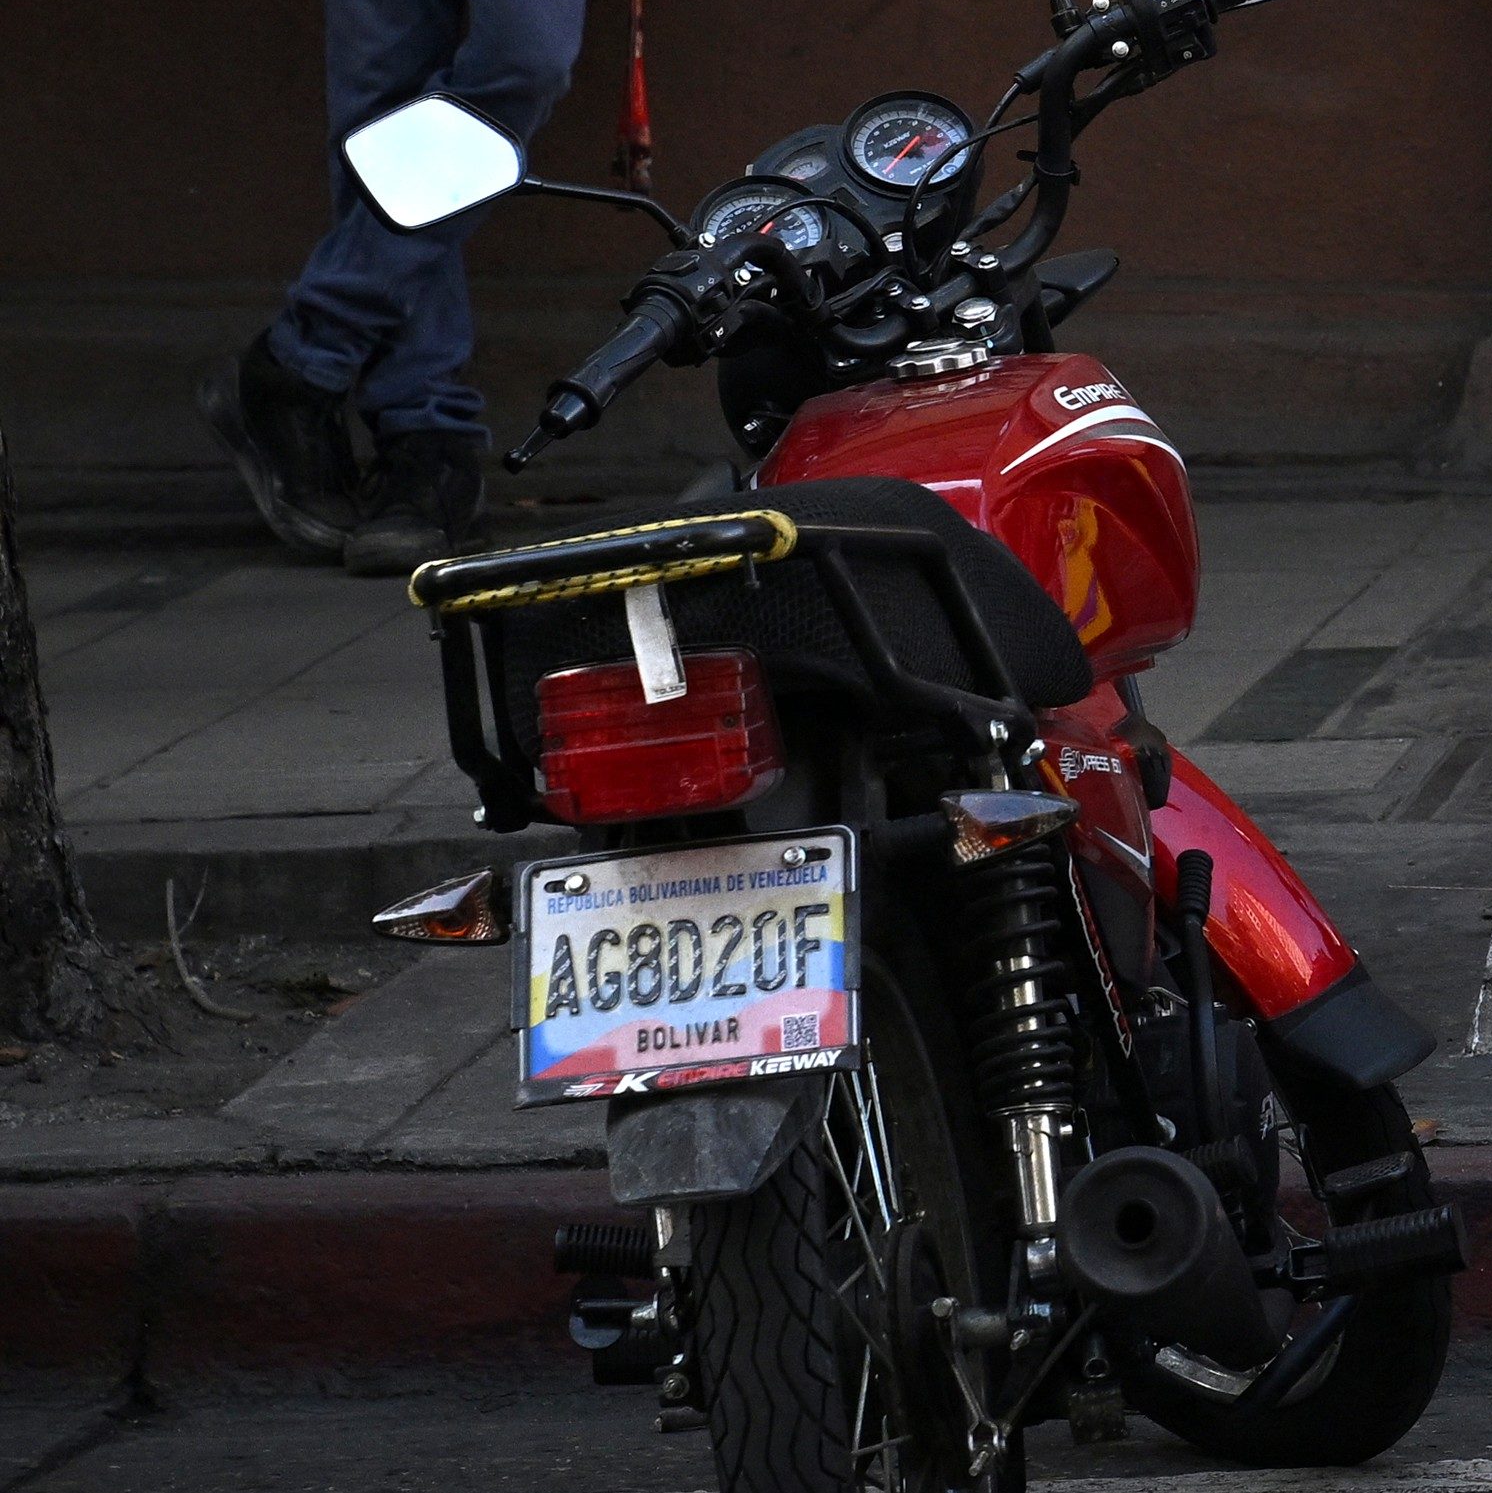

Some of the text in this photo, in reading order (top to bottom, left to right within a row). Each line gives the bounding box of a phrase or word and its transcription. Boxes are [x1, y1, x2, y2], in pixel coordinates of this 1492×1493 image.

[629, 876, 721, 904] BOLIVARIANA
[727, 874, 745, 892] DE
[749, 865, 828, 890] VENEZUELA
[545, 903, 829, 1018] AG8D20F
[636, 1017, 739, 1053] BOLIVAR
[750, 1050, 842, 1076] KEEWAY
